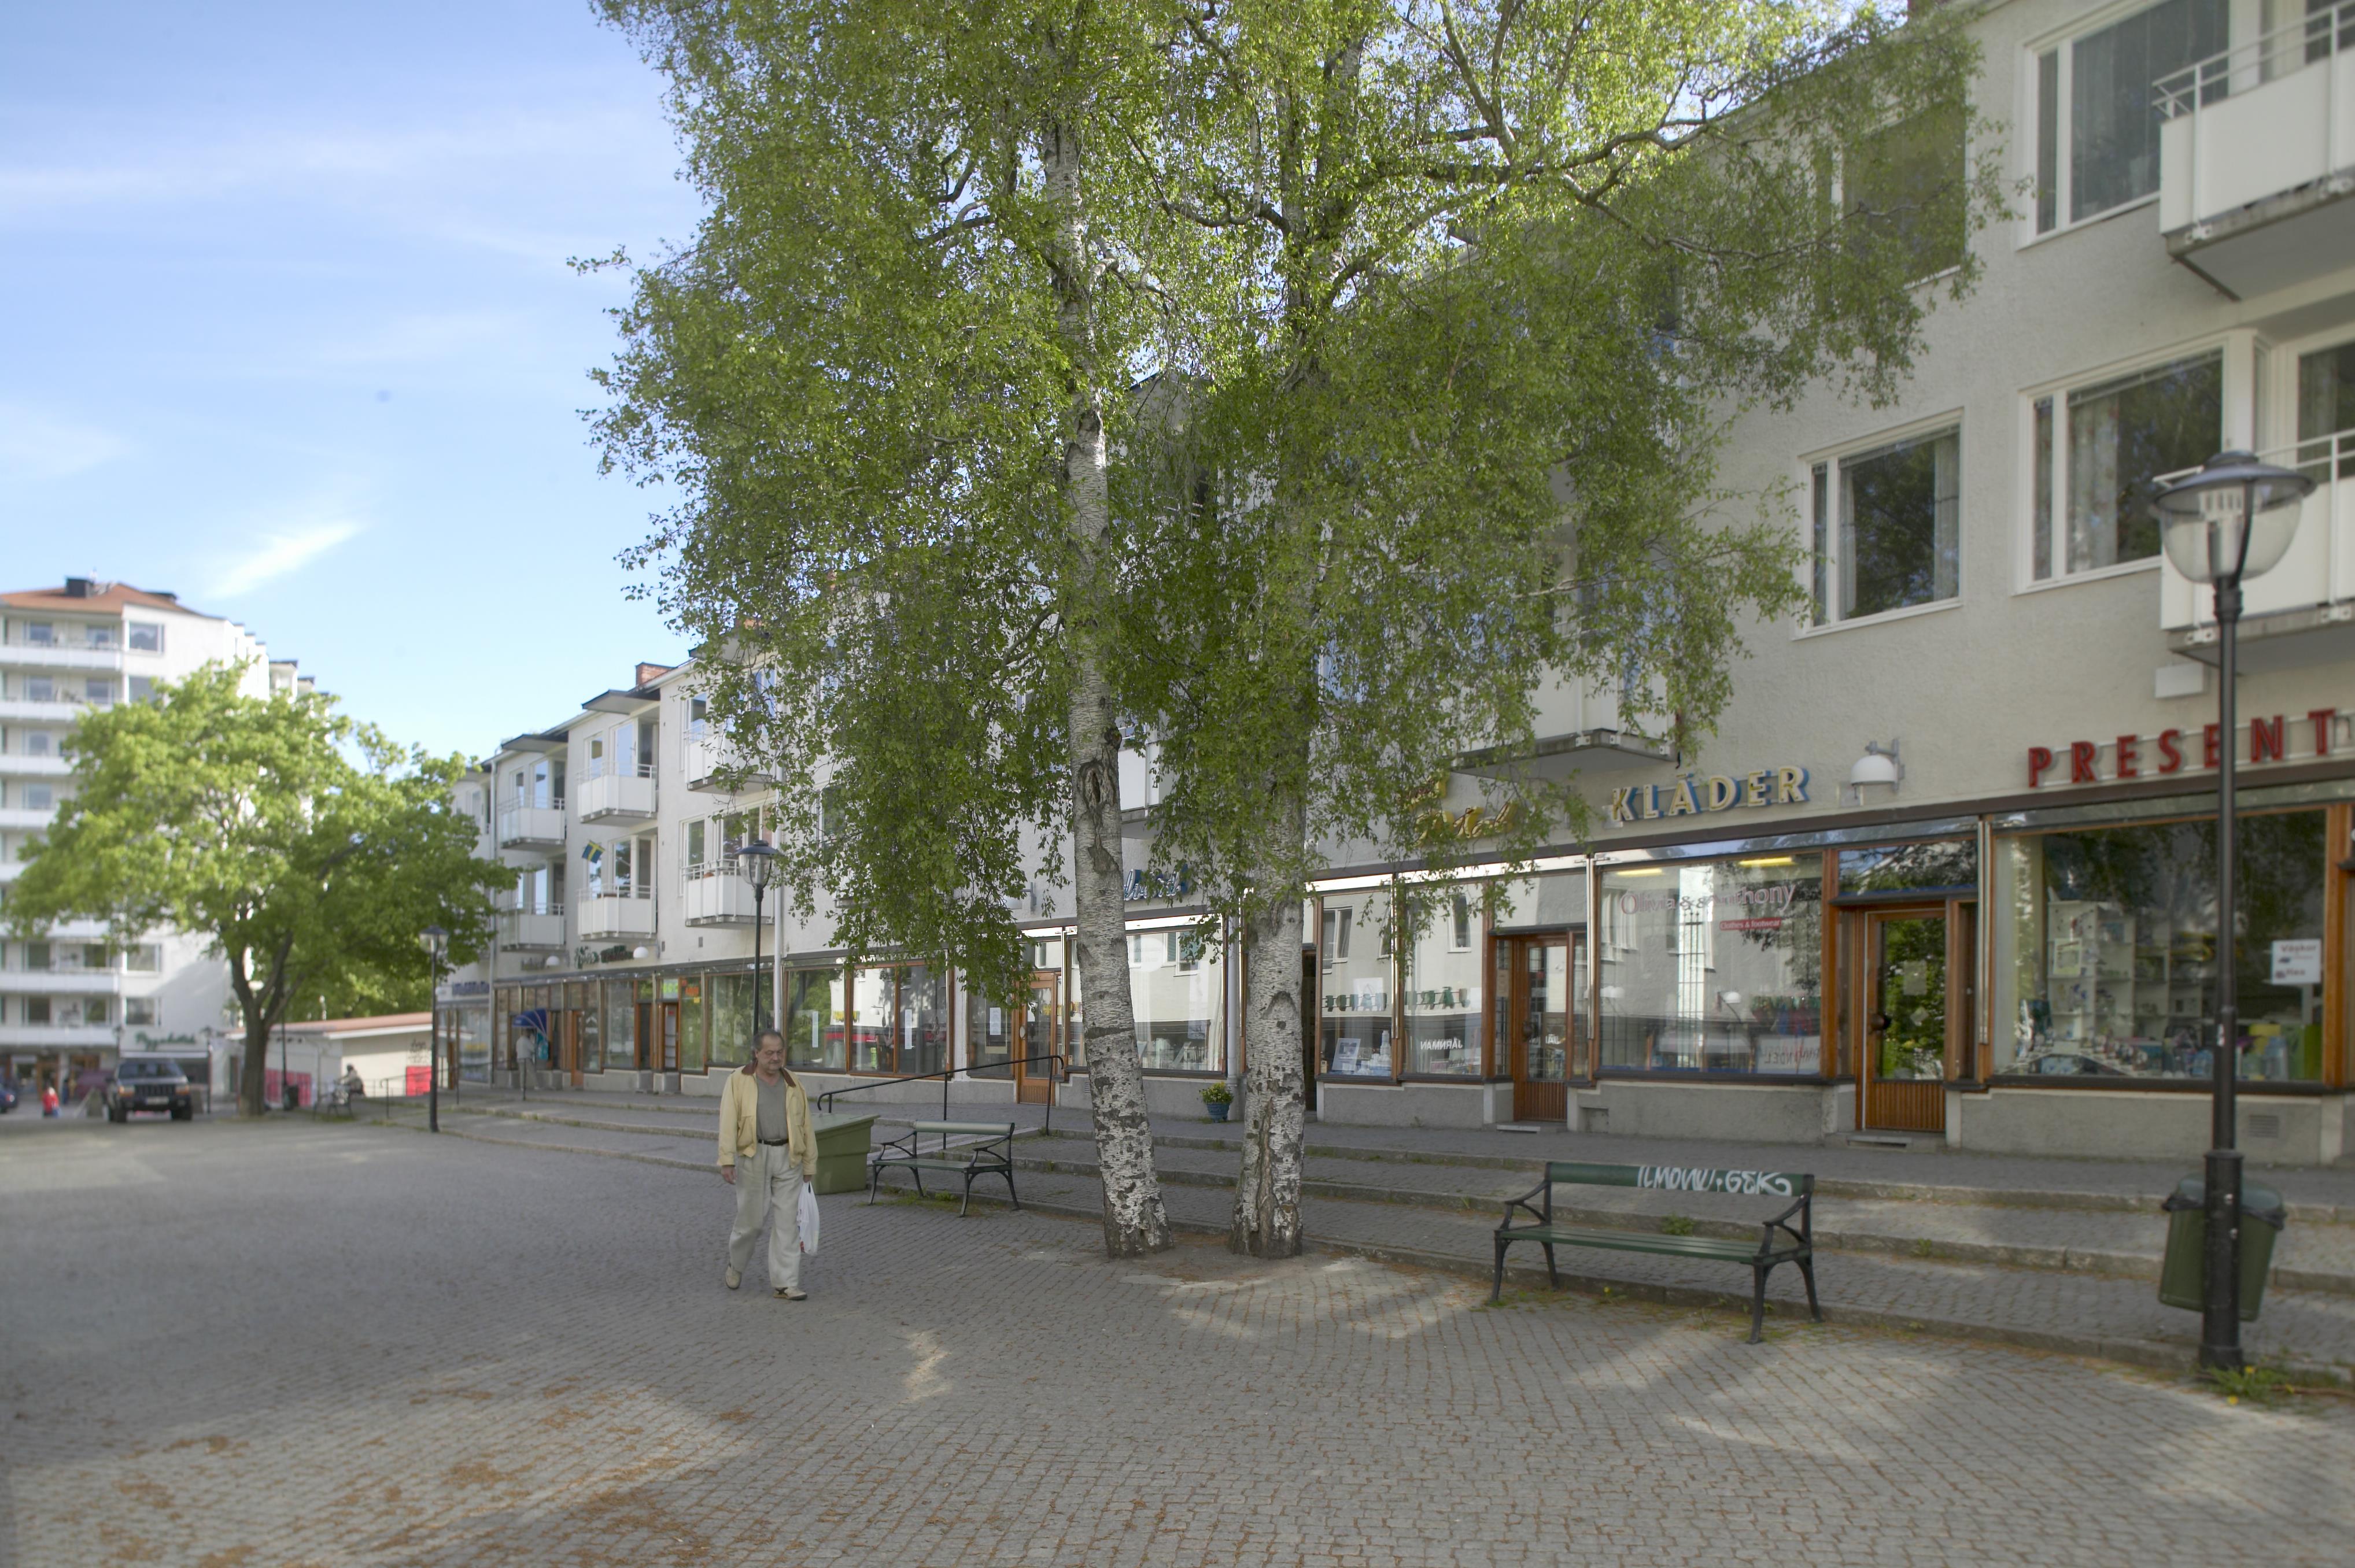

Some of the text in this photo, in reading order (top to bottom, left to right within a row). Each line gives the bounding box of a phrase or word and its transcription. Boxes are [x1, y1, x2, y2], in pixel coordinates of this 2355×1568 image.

[2028, 708, 2336, 788] PRESENT
[1611, 765, 1809, 821] KLÄDER
[1621, 893, 1675, 914] Olivia
[1706, 884, 1796, 912] Anthony
